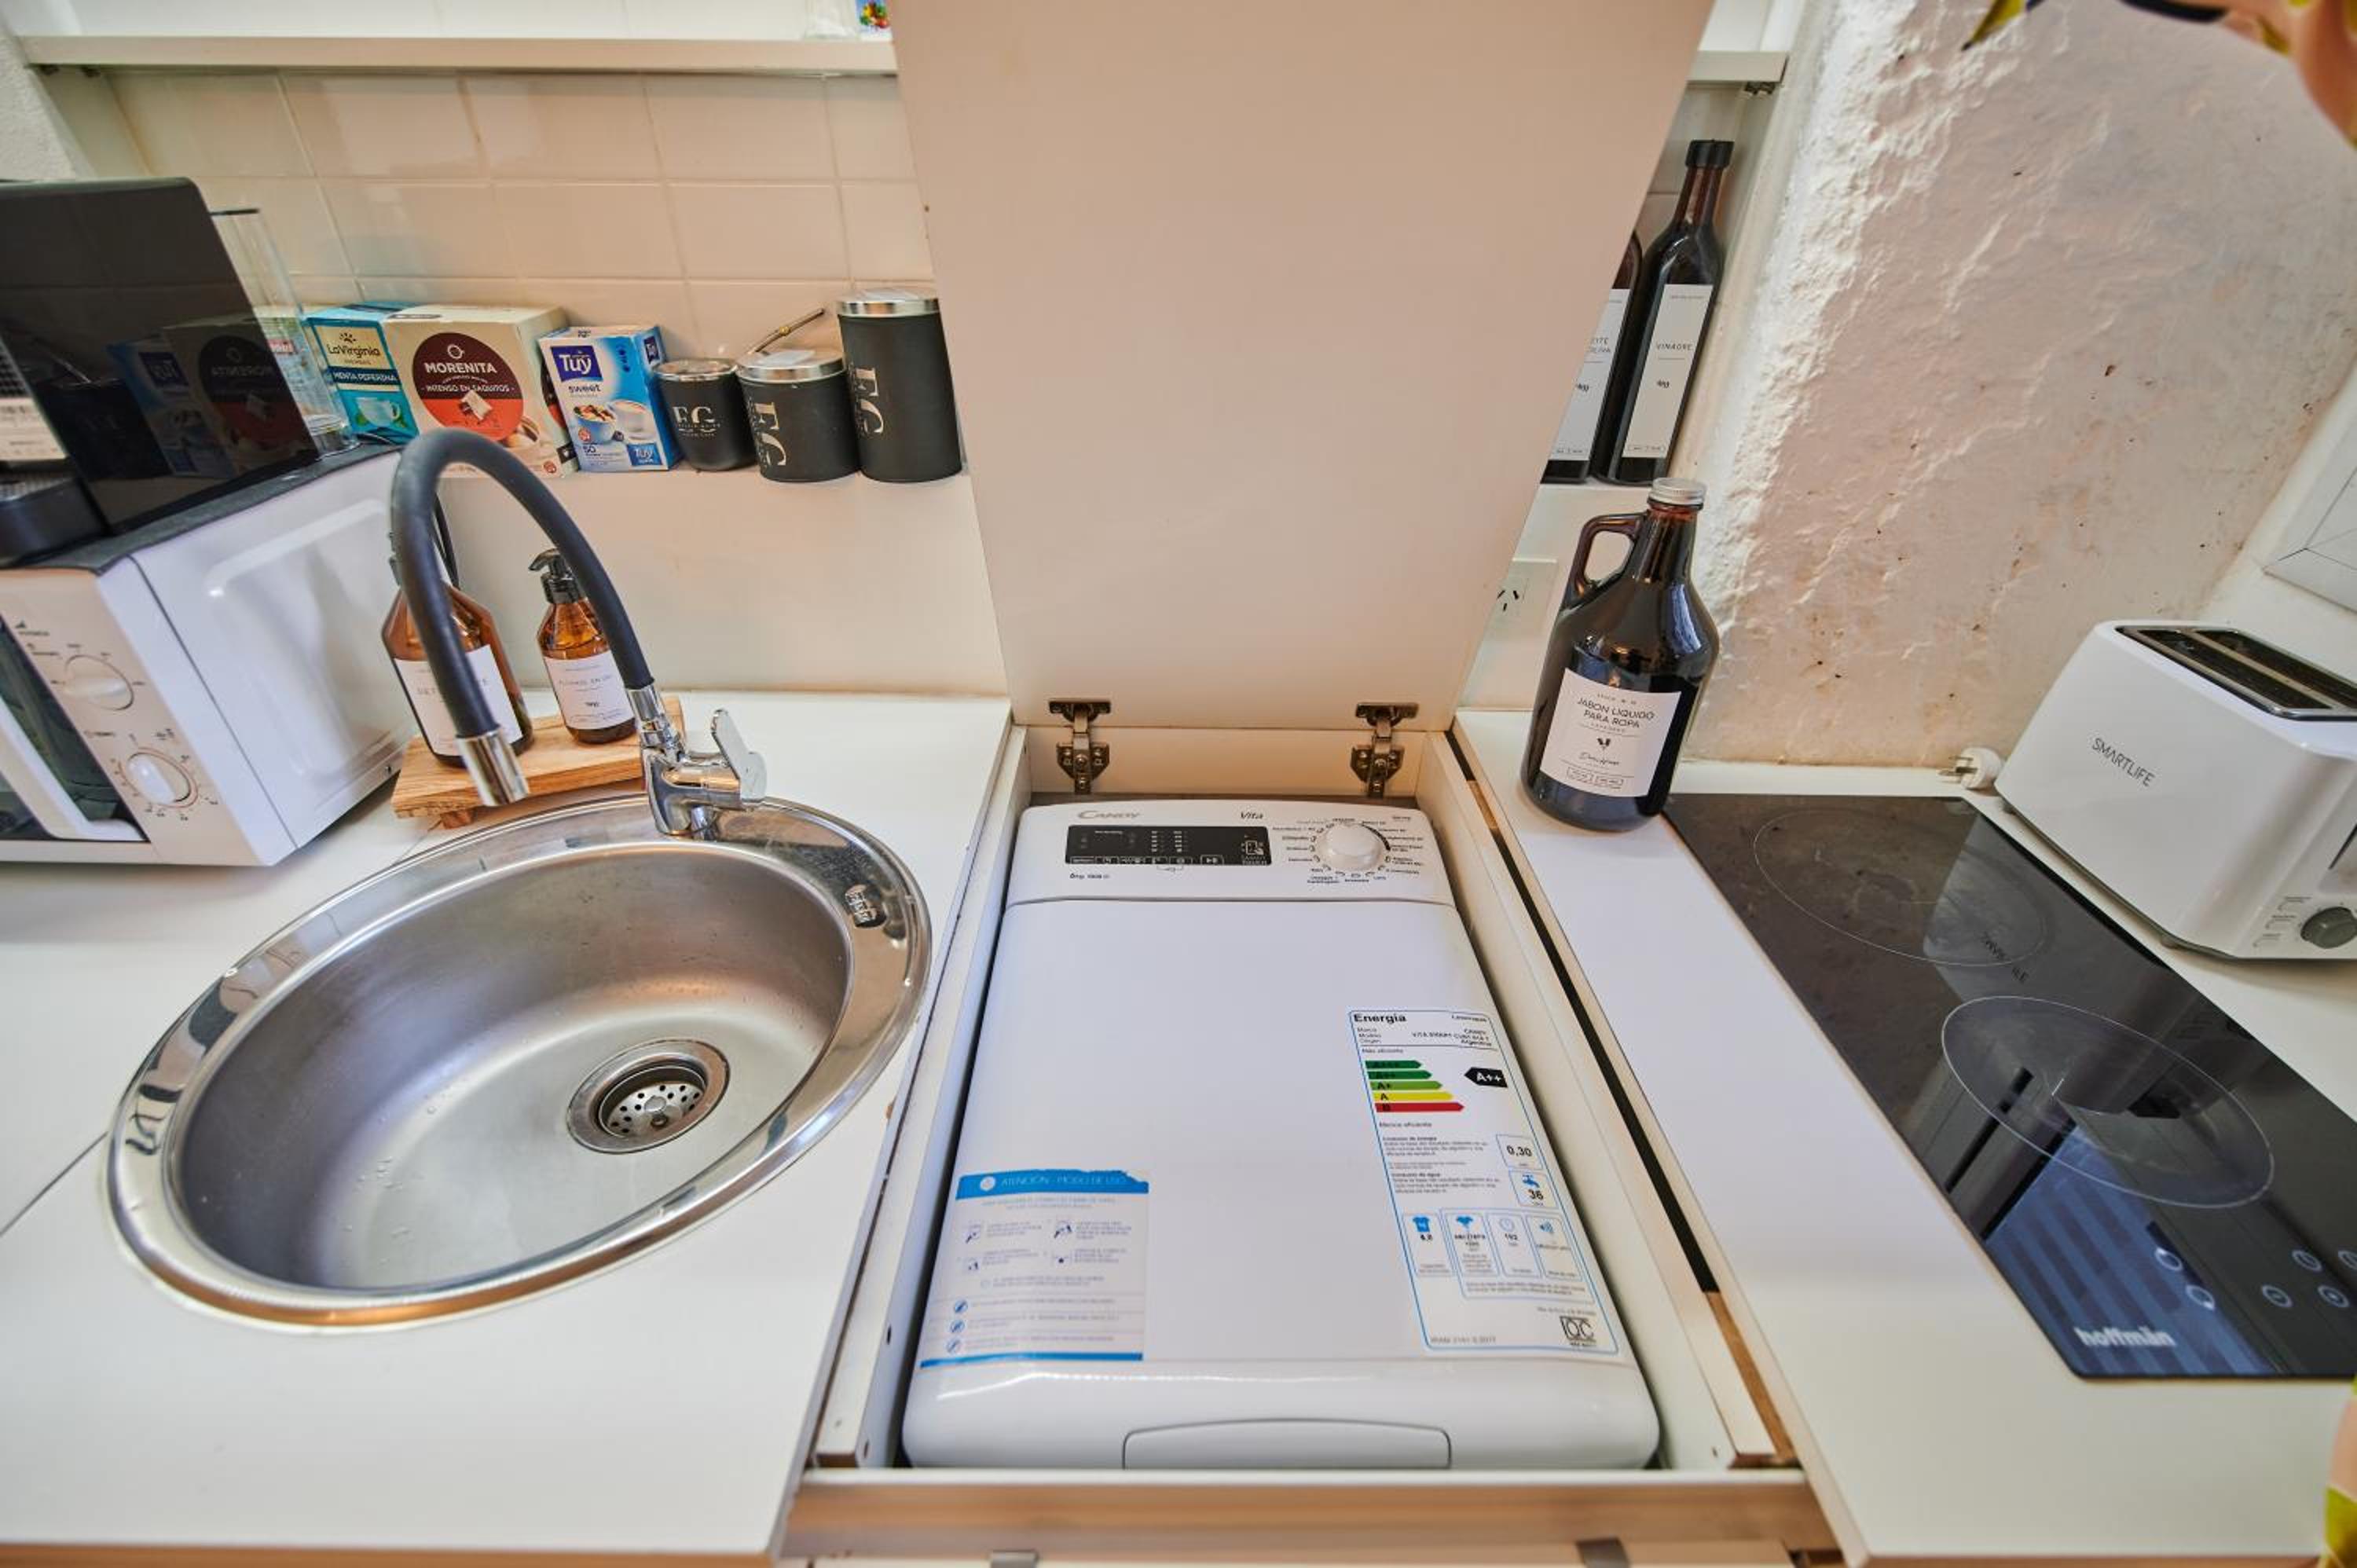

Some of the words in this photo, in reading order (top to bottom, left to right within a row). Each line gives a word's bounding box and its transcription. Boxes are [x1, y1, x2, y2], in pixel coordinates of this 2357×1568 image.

[424, 362, 497, 373] MORENITA
[559, 354, 592, 375] Tuy
[1578, 698, 1610, 714] JABON
[1611, 708, 1655, 721] LIQUIDO
[1583, 710, 1610, 724] PARA
[1611, 716, 1640, 728] ROPA
[2091, 737, 2155, 787] SMARTLIFE
[1476, 1072, 1501, 1082] A++
